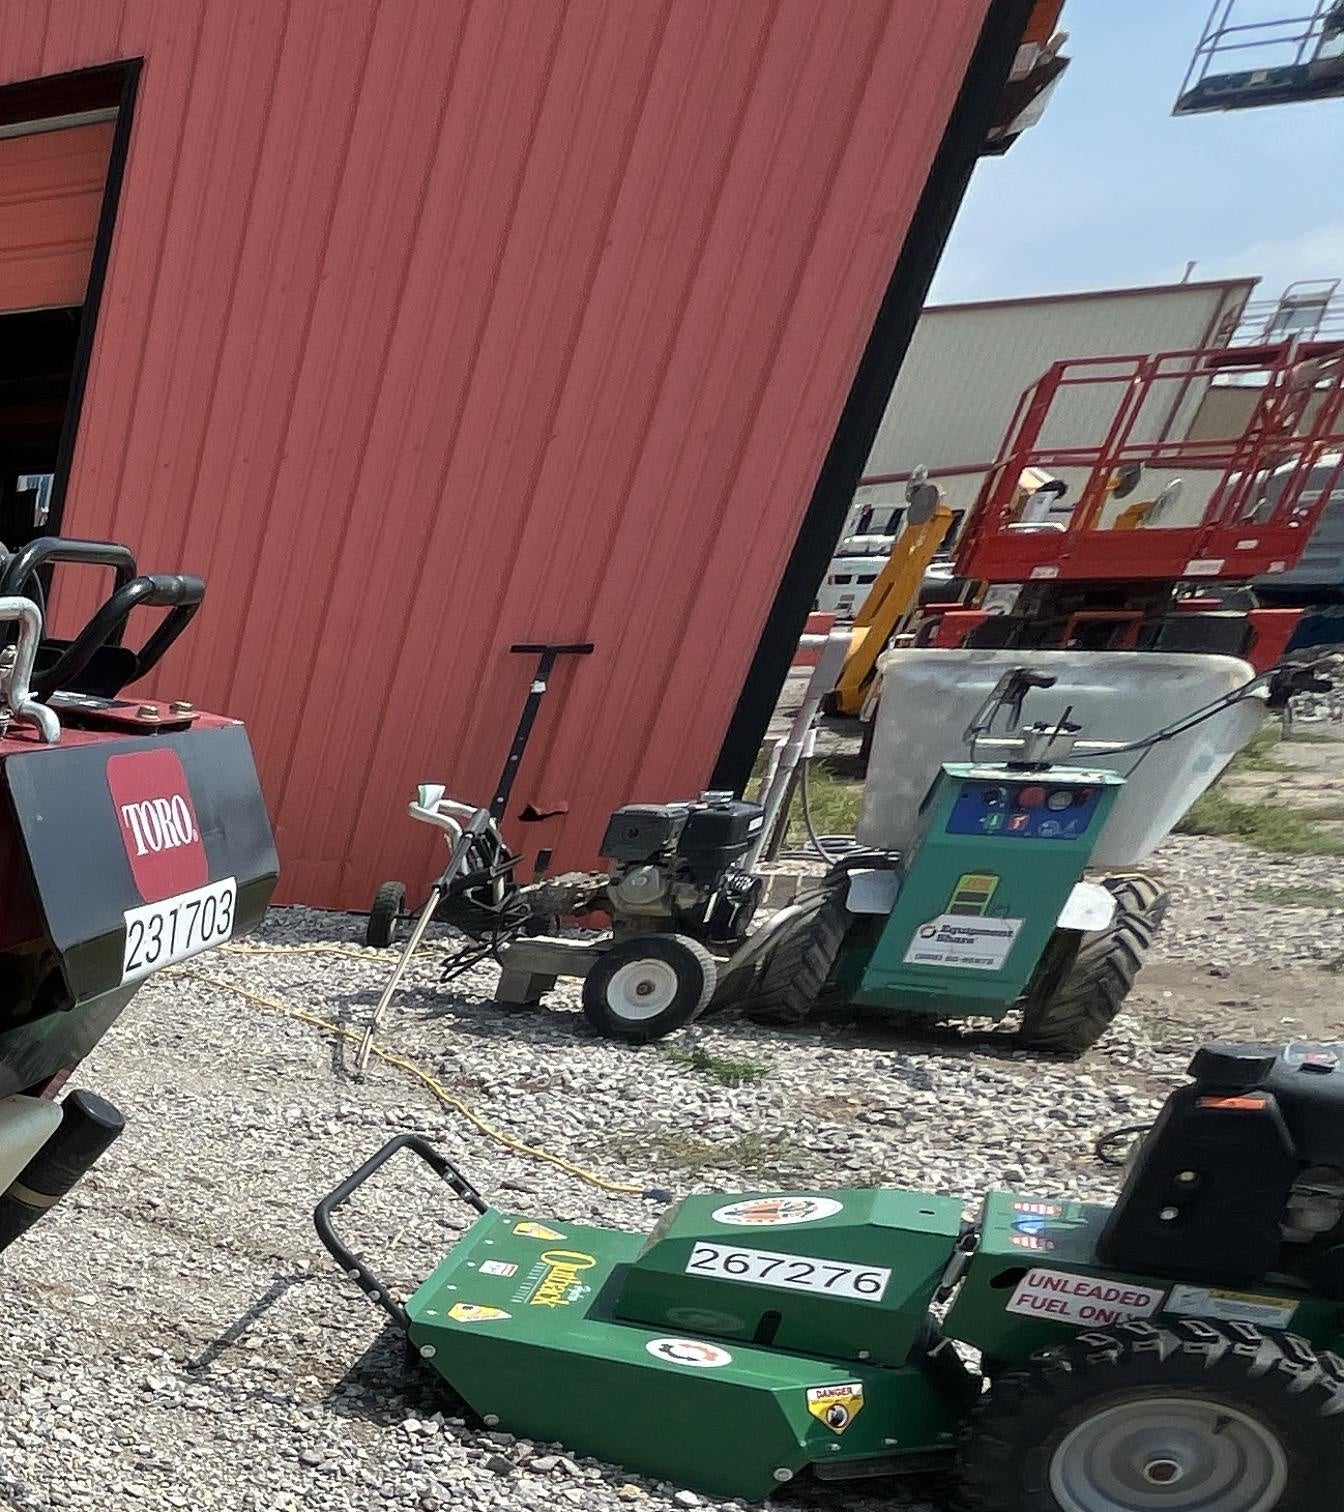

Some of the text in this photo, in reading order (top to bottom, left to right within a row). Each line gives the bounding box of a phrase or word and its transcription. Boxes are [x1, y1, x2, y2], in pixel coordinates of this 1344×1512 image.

[121, 794, 194, 856] TORO
[125, 888, 233, 973] 231703
[936, 933, 975, 944] Share
[940, 924, 1014, 938] Equipment
[690, 1248, 882, 1294] 267276
[1015, 1293, 1072, 1316] FUEL
[1027, 1273, 1152, 1308] UNLEADED
[815, 1386, 854, 1400] DANGER
